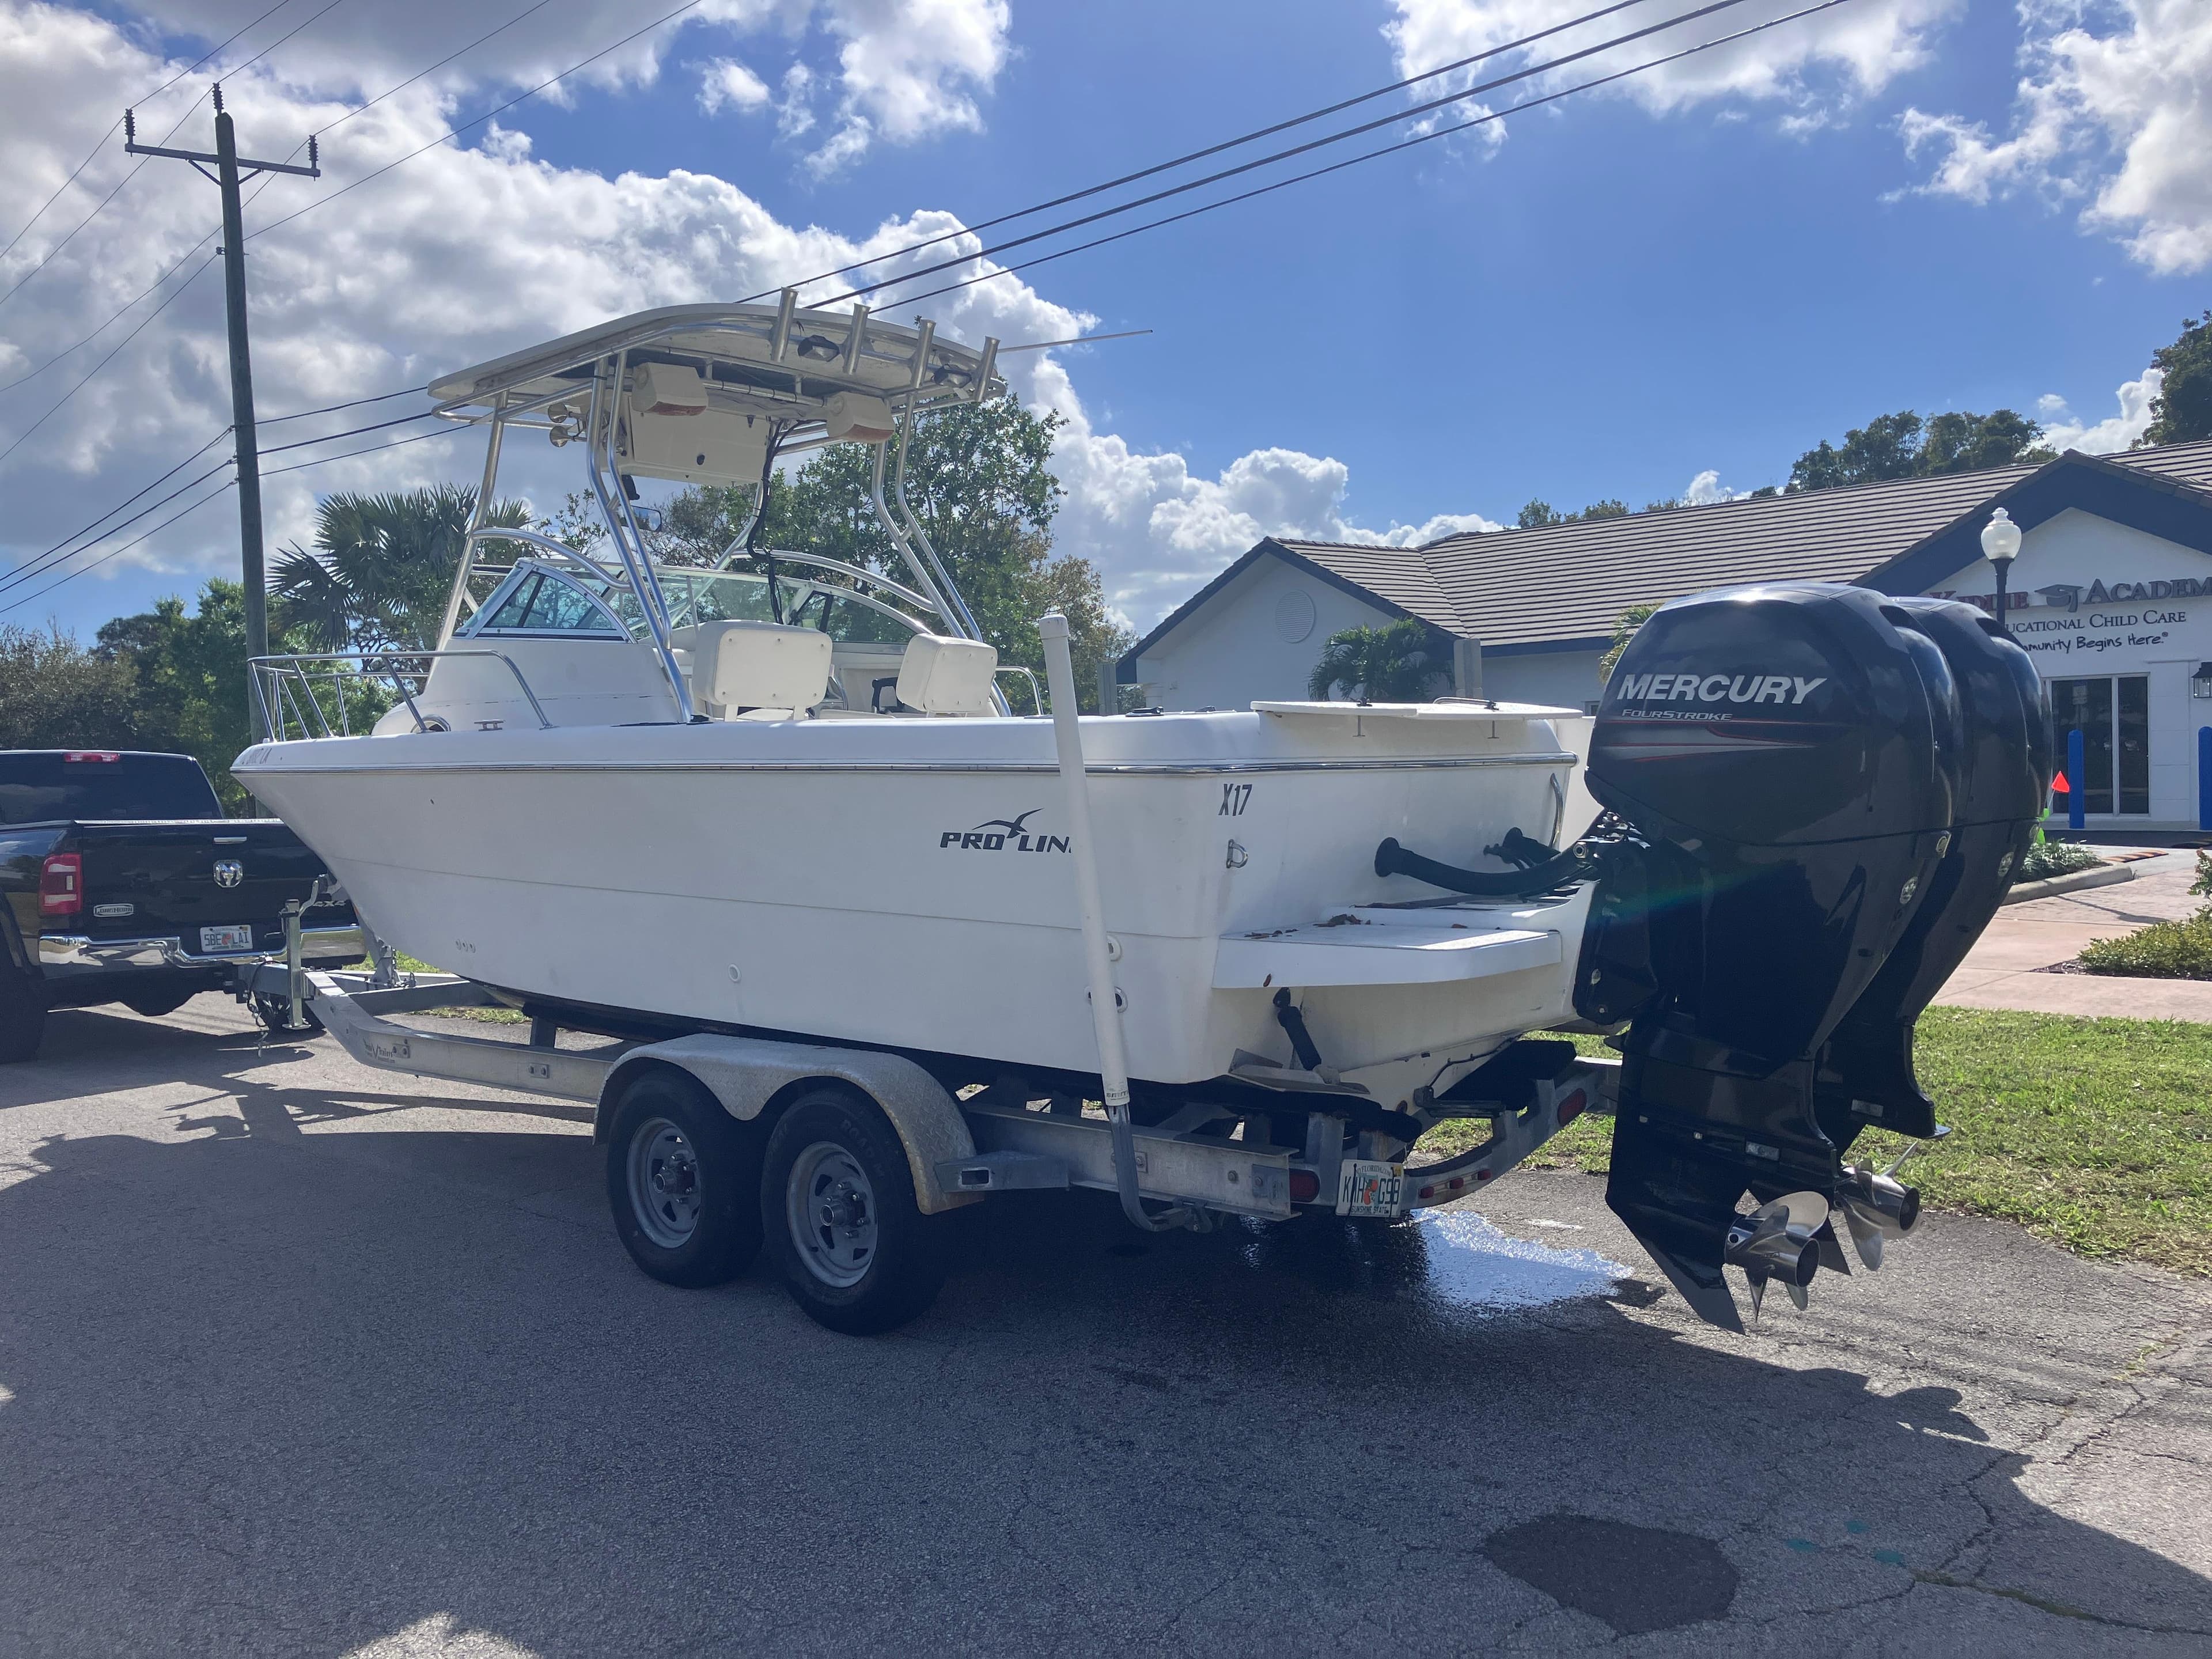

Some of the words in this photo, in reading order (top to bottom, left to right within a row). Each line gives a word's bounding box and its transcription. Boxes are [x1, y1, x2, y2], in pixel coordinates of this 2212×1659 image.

[2083, 576, 2212, 605] ACADEM
[2006, 619, 2085, 633] UCATIONAL
[2089, 613, 2138, 628] CHILD
[2143, 609, 2187, 624] CARE
[2023, 638, 2071, 654] munity
[2076, 636, 2122, 652] Begins
[1616, 673, 1828, 704] MERCURY
[1218, 783, 1253, 817] X17
[940, 832, 1005, 850] PRO
[1017, 835, 1072, 854] LIN
